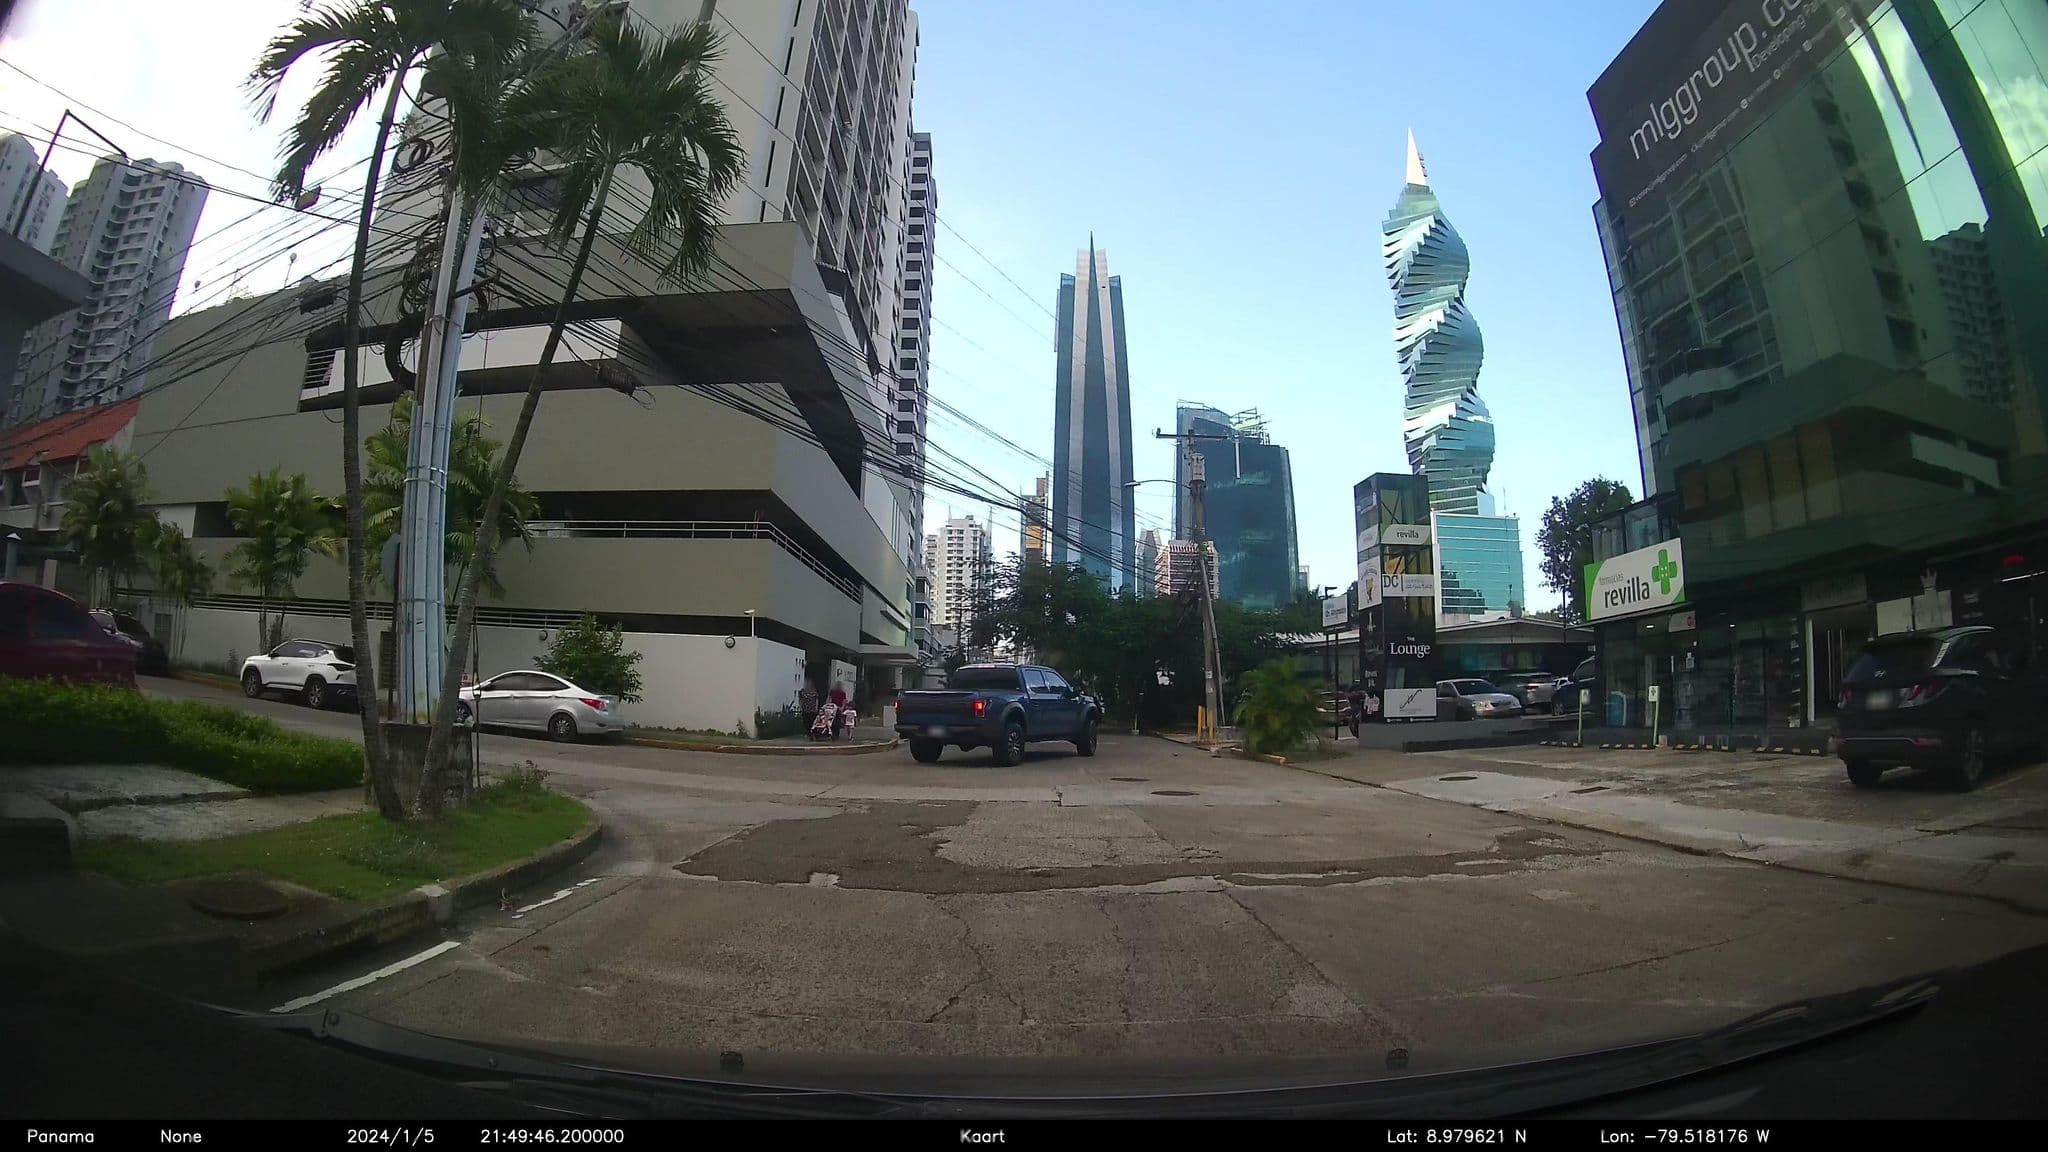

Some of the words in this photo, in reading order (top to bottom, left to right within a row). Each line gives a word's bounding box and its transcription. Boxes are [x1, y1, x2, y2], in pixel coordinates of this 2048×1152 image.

[1630, 0, 1801, 159] mlggroup.c
[1396, 529, 1419, 539] revilla
[1383, 574, 1399, 588] DC
[1604, 576, 1650, 609] revilla
[1389, 642, 1432, 659] Lounge
